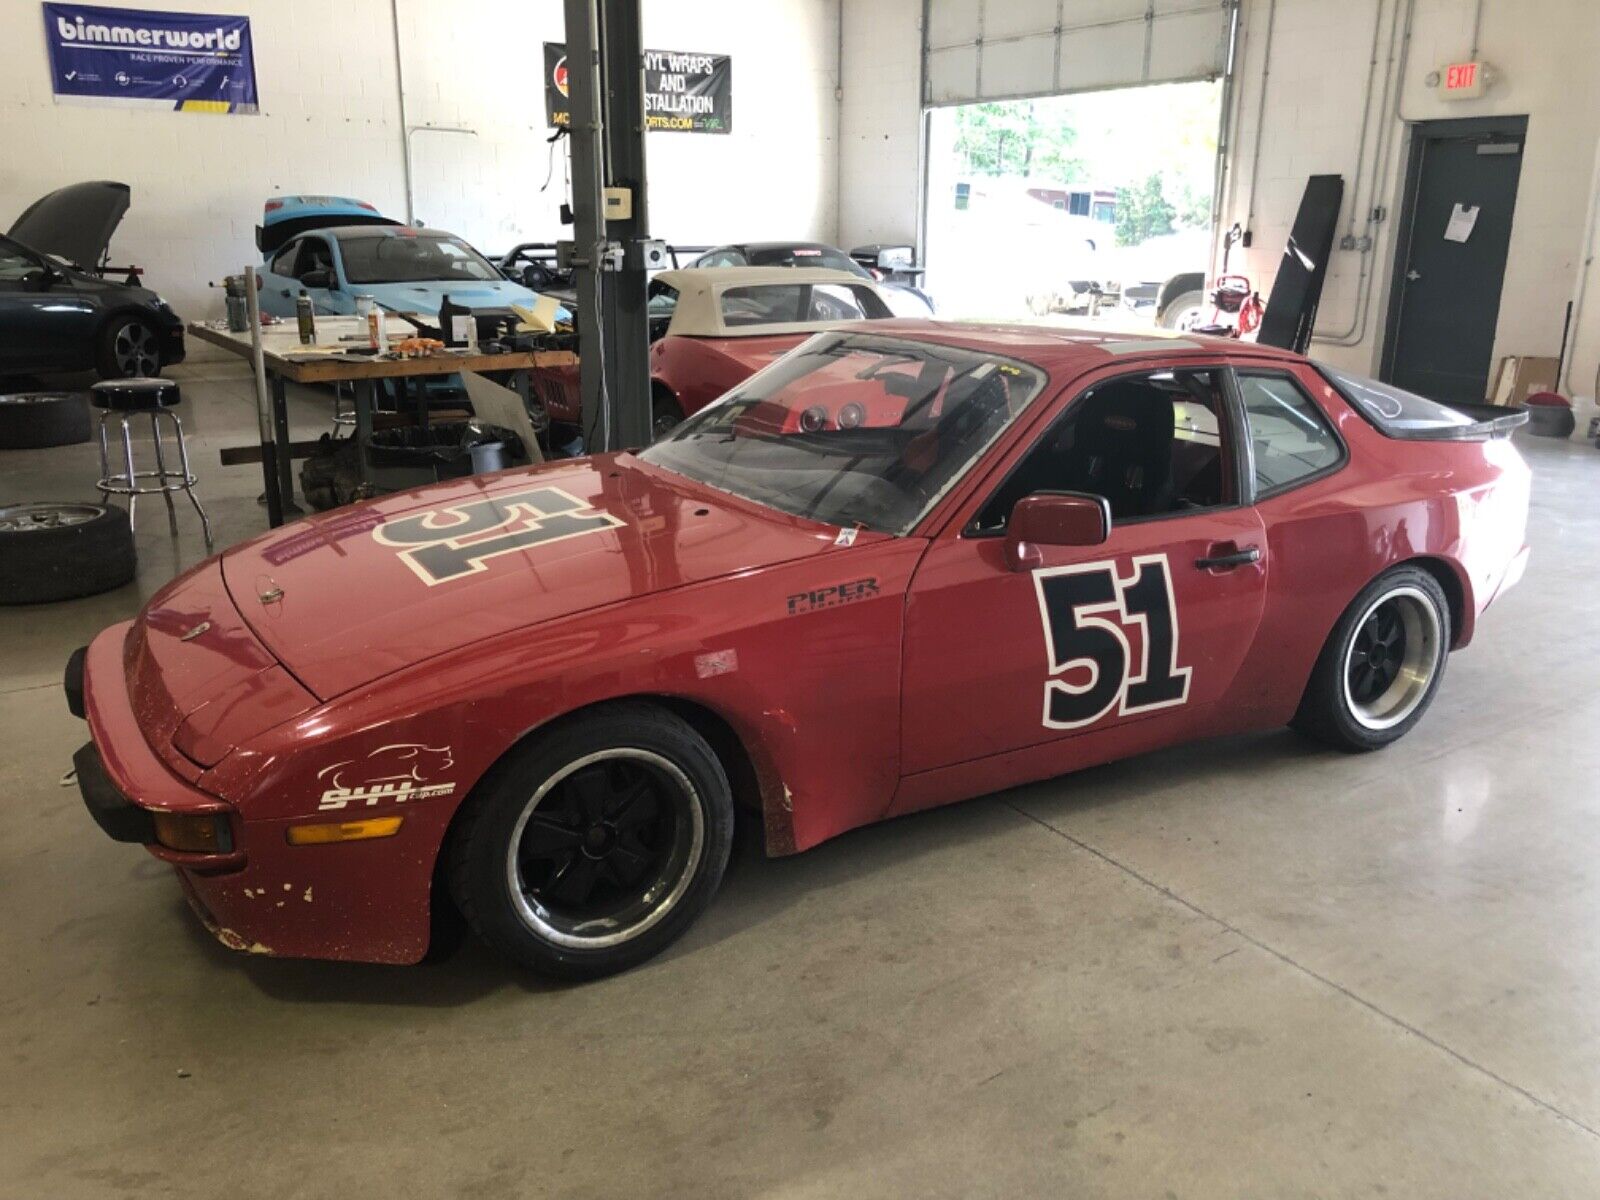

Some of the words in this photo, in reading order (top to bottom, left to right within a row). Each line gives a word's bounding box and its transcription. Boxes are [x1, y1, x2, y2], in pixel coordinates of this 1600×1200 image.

[57, 16, 240, 50] bimmerworld
[153, 54, 185, 64] PROVEN
[187, 56, 242, 67] PERFORMANCE
[643, 52, 666, 71] NYL
[667, 55, 713, 75] WRAPS
[660, 74, 685, 92] AND
[1446, 64, 1476, 90] EXIT
[645, 93, 713, 113] STALLATION
[645, 116, 692, 129] ORTS.COM
[372, 487, 627, 587] 51
[787, 577, 880, 608] PIPER
[1032, 553, 1192, 729] 51
